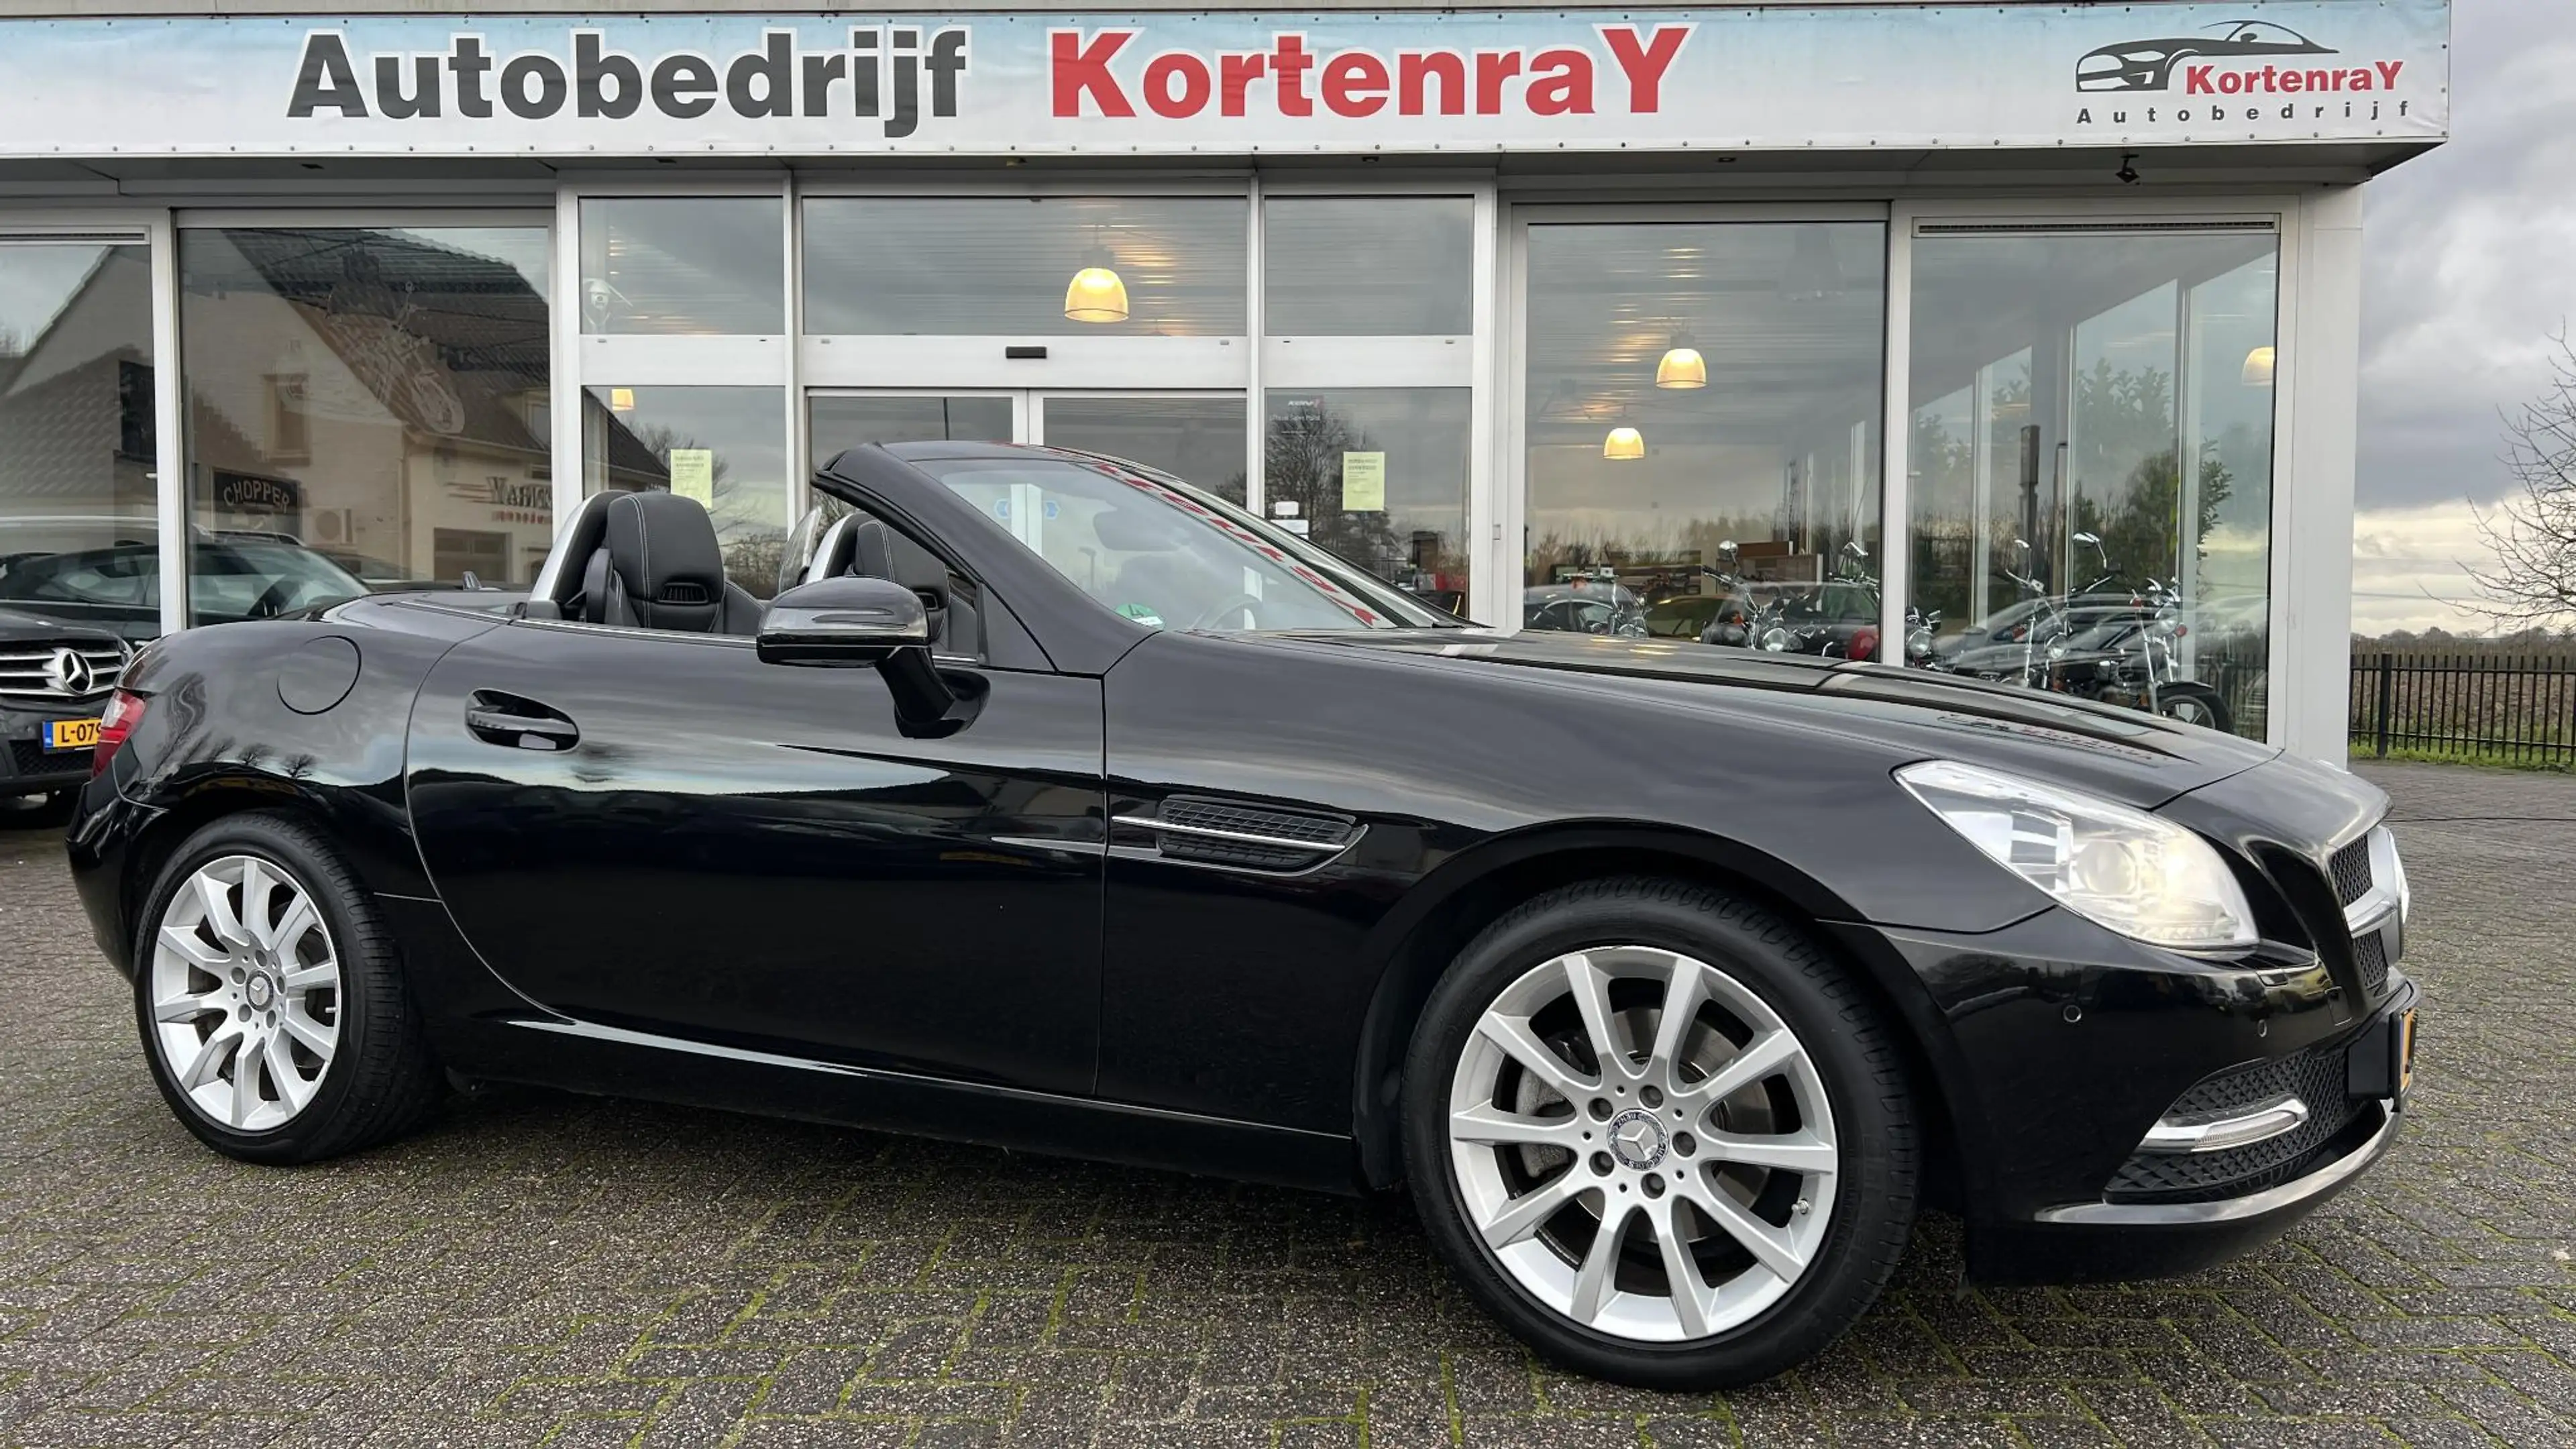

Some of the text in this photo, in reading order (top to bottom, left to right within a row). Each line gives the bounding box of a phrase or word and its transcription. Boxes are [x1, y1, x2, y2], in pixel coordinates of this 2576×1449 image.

[288, 27, 1688, 138] Autobedrijf KortenraY
[2186, 60, 2402, 95] KortenraY
[2076, 101, 2408, 124] Autobedrijf
[223, 478, 290, 514] CHOPPER
